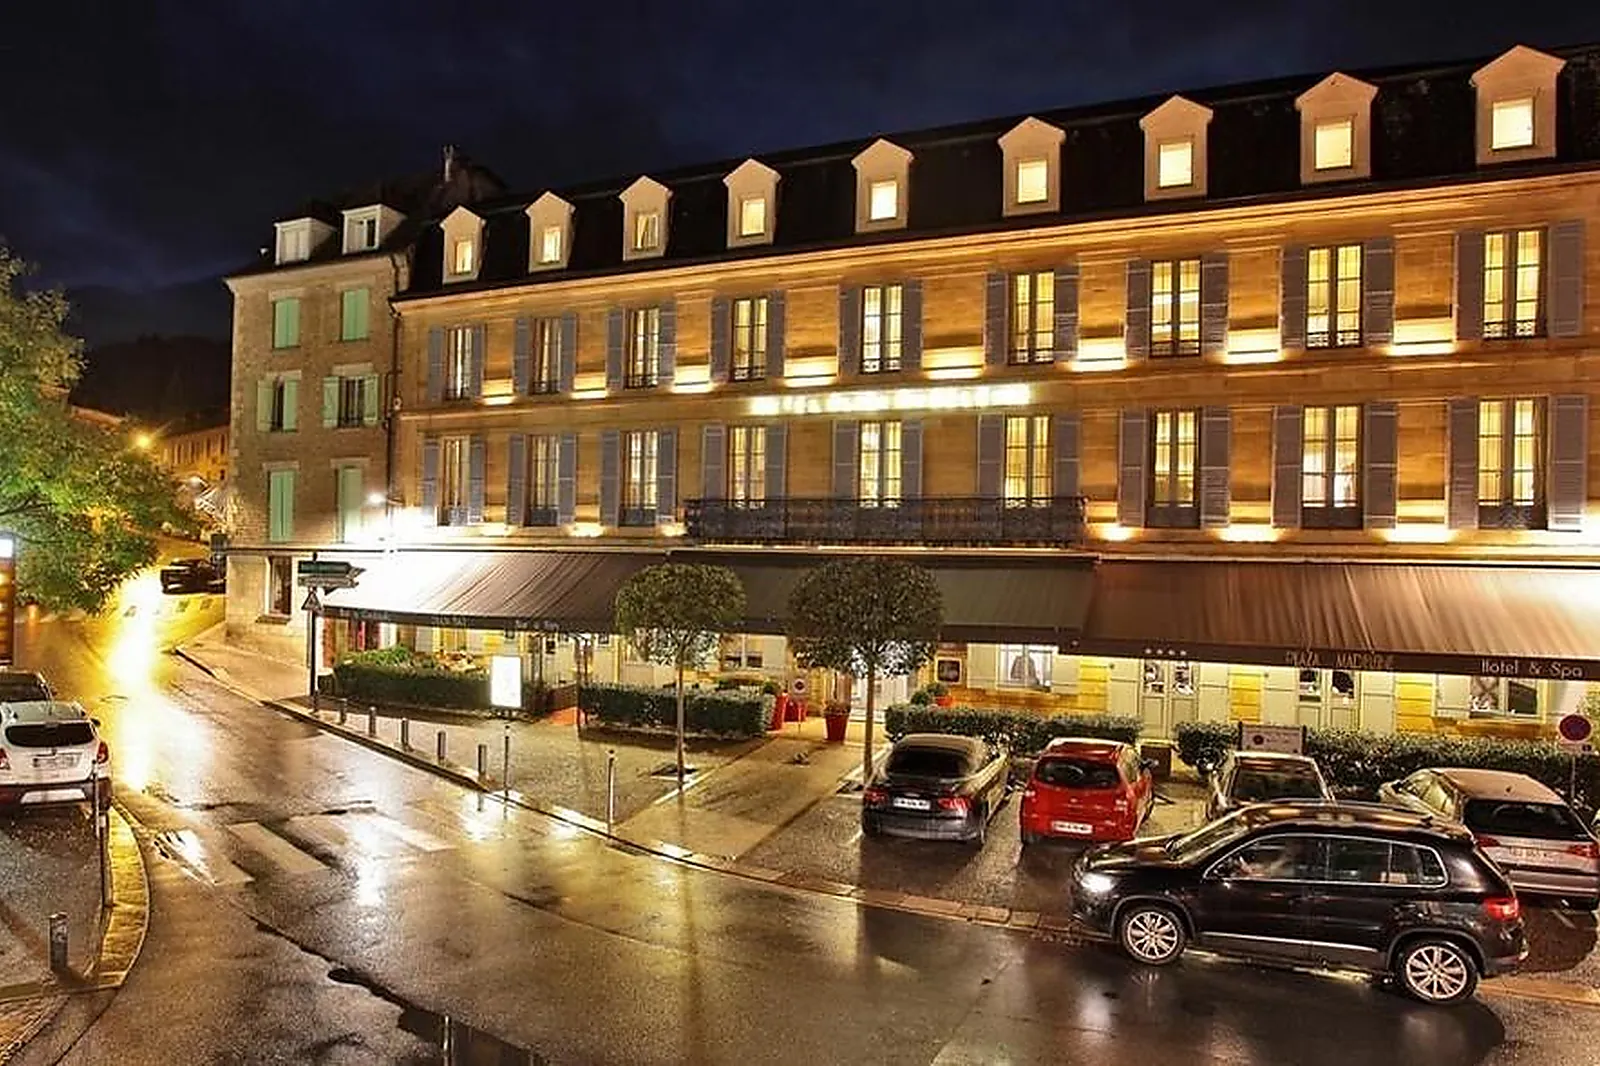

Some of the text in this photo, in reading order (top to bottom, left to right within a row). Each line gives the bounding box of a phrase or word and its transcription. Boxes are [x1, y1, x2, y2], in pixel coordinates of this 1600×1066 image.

[1481, 659, 1583, 679] Hotel & Spa
